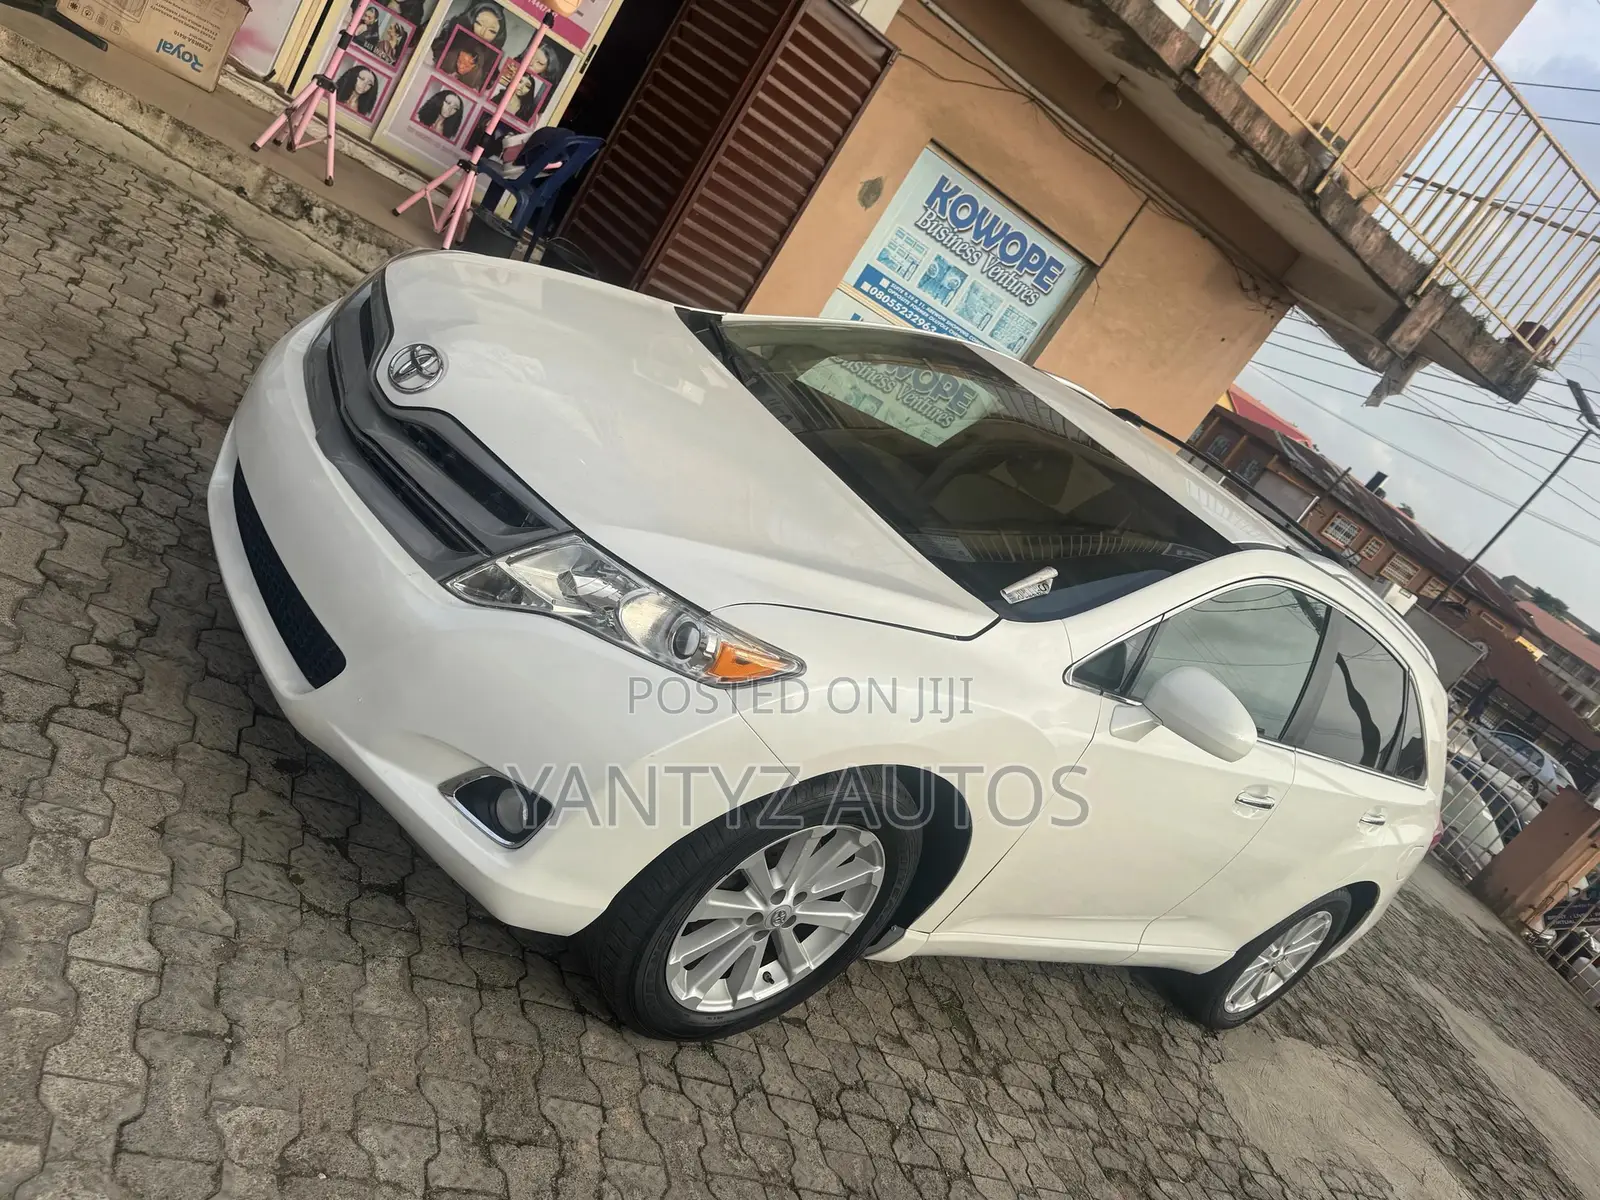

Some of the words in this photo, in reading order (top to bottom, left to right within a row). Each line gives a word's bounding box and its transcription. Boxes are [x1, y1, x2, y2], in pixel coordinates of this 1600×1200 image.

[155, 38, 204, 73] Royal
[915, 208, 982, 265] Business
[980, 252, 1039, 306] Ventures
[924, 174, 1066, 294] KOWOPE
[869, 285, 937, 332] 08055232963
[887, 286, 911, 306] OPPOSITE
[909, 302, 929, 318] FORMER
[890, 282, 904, 294] SUITE
[945, 319, 968, 338] SHOPPING
[895, 382, 955, 428] Ventures
